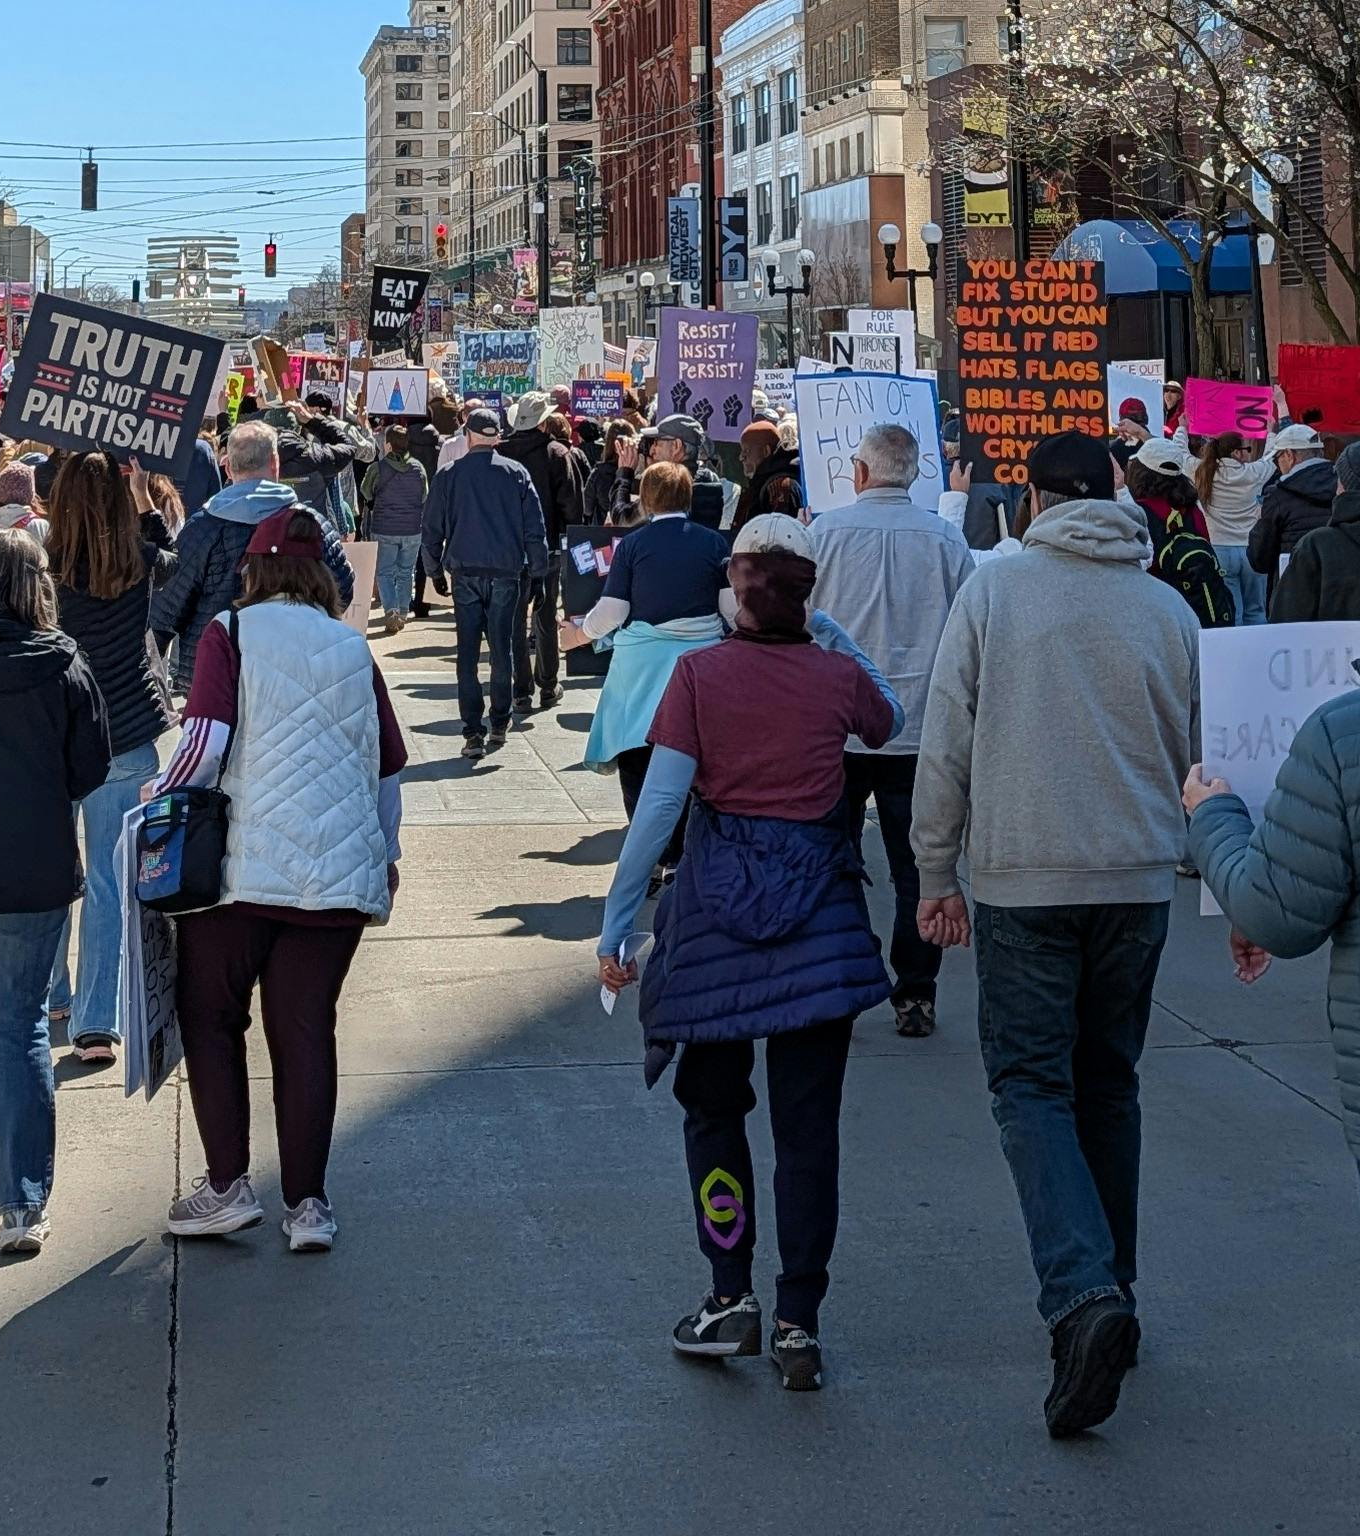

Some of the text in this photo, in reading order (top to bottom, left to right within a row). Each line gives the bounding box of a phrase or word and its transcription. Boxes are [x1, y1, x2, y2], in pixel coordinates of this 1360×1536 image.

[967, 213, 1007, 224] DYT
[670, 205, 679, 280] ATYPICAL
[680, 208, 688, 280] MIDWEST
[721, 199, 745, 281] DYT
[689, 246, 698, 280] CITY
[967, 260, 1096, 281] YOU CAN'T
[380, 278, 419, 300] EAT
[962, 281, 1098, 303] FIX STUPID
[389, 298, 406, 308] THE
[871, 311, 894, 322] FOR
[956, 305, 1107, 327] BUT YOU CAN
[866, 322, 895, 333] RULE
[464, 333, 536, 363] Fabulously
[857, 336, 896, 354] THRONES
[963, 331, 1098, 352] SELL IT RED
[47, 311, 203, 396] TRUTH
[859, 357, 894, 371] CROWNS
[1139, 364, 1161, 374] OUT
[76, 373, 146, 411] IS NOT
[591, 389, 620, 397] KINGS
[816, 380, 876, 419] FAN
[886, 381, 912, 416] OF
[965, 388, 1104, 411] BIBLES AND
[575, 401, 619, 409] AMERICA
[1235, 395, 1268, 432] NO
[20, 388, 181, 460] PARTISAN
[965, 413, 1105, 438] WORTHLESS
[816, 420, 922, 455] HUN
[983, 439, 1039, 460] CRY
